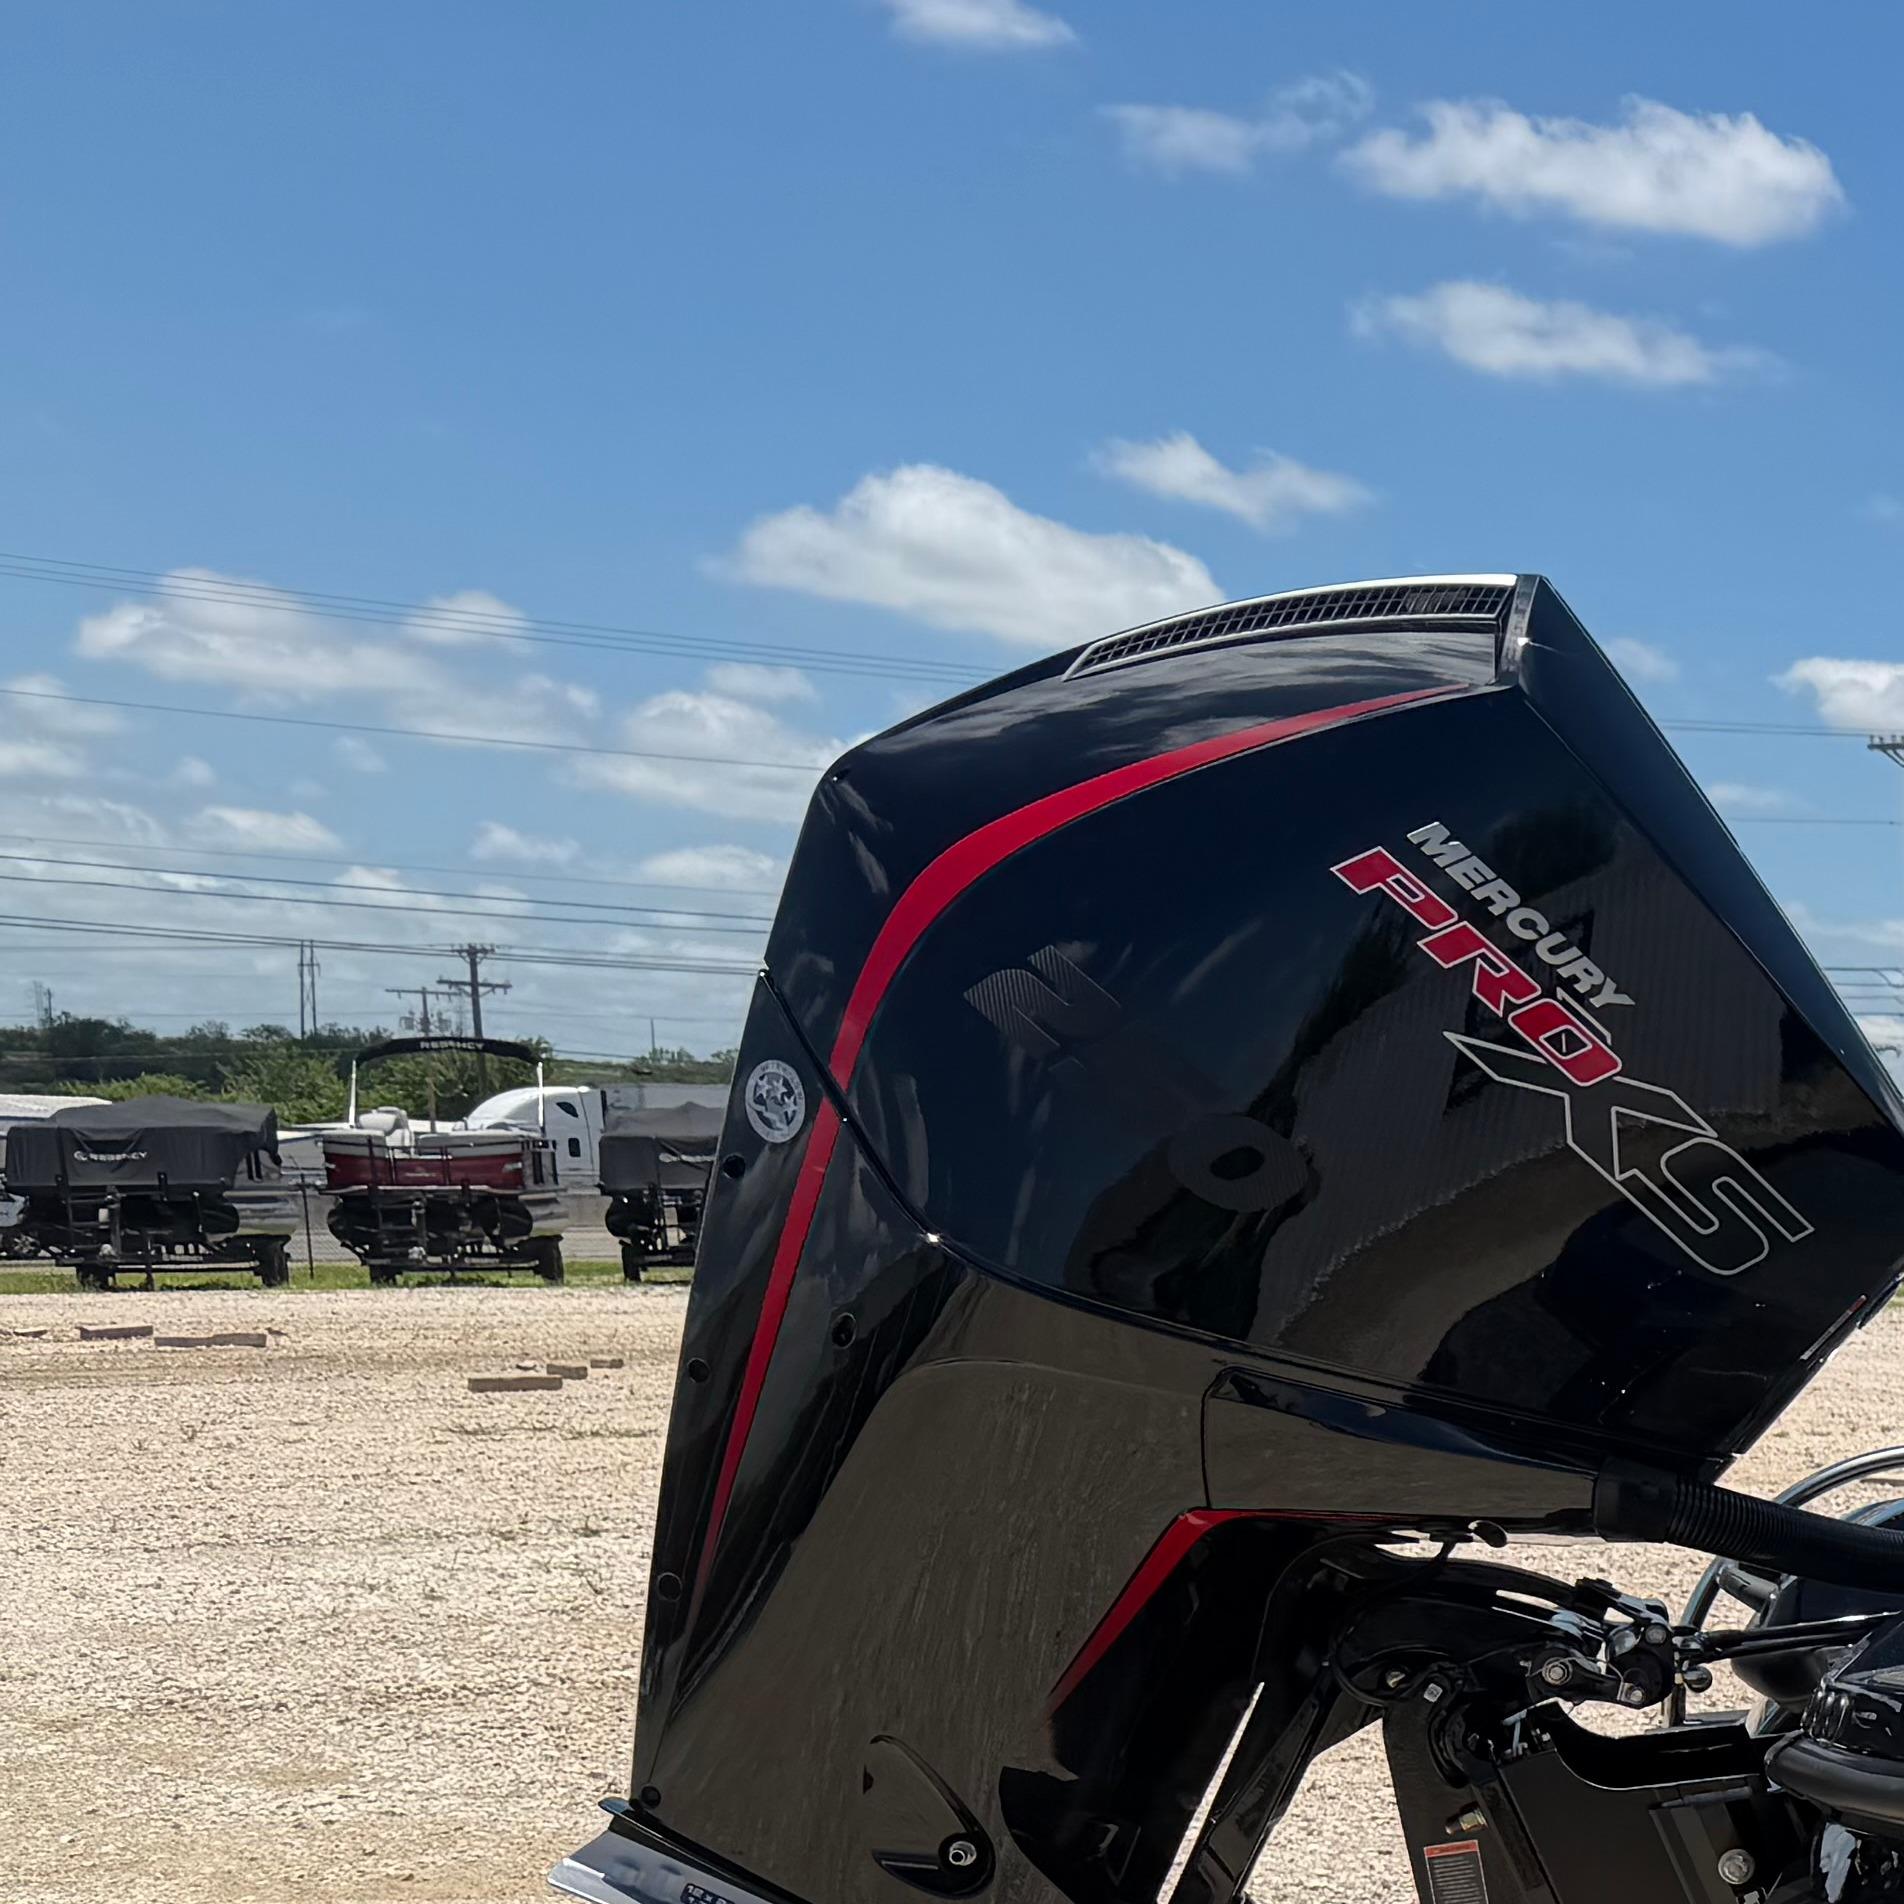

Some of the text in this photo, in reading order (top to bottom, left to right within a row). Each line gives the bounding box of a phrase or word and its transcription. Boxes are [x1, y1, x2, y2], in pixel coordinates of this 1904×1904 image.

[1330, 846, 1815, 1275] PRO XS
[1406, 821, 1635, 1008] MERCURY
